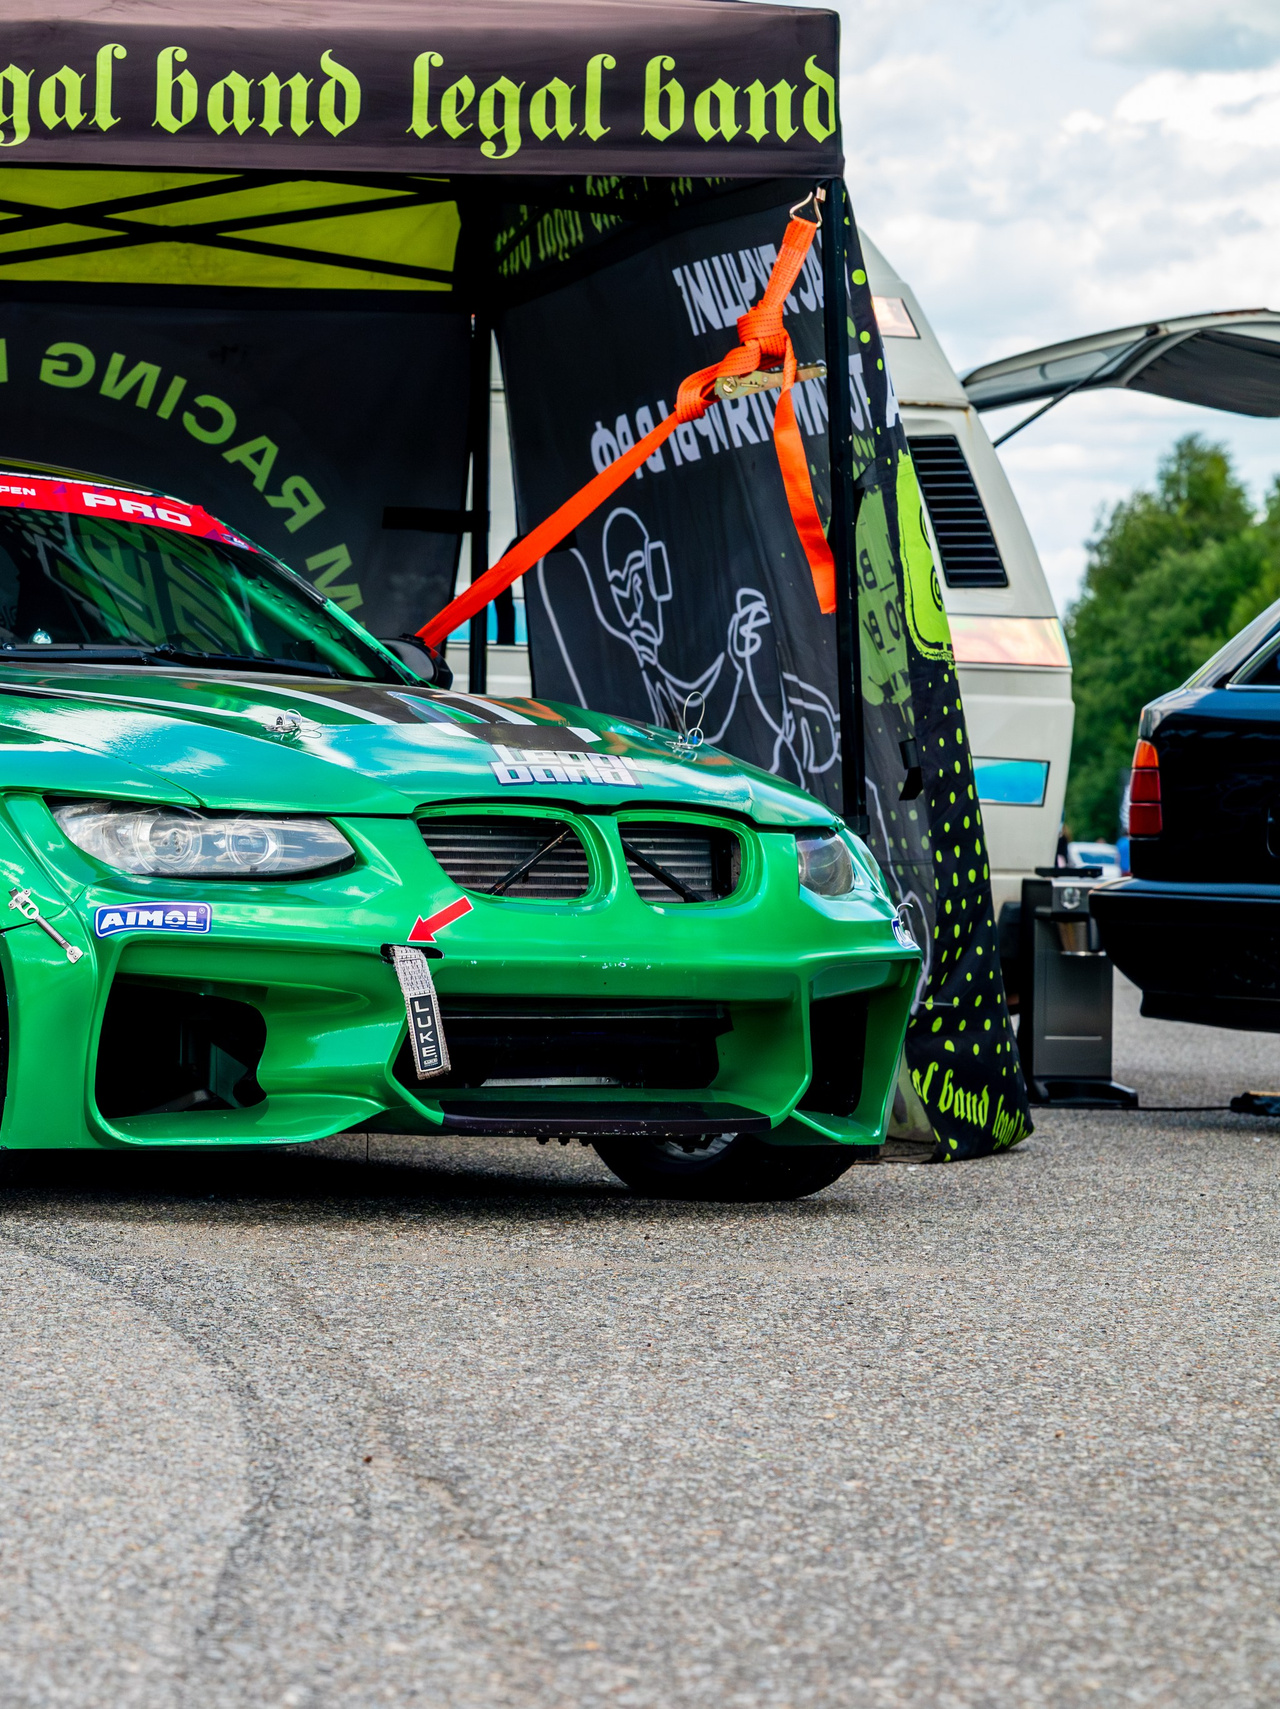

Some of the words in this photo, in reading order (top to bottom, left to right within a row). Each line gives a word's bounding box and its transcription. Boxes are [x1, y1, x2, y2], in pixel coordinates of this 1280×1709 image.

[152, 46, 361, 137] band
[405, 51, 616, 159] legal
[641, 55, 836, 143] band
[82, 491, 192, 527] PRO
[100, 910, 204, 930] AIMOL
[937, 1069, 990, 1129] band
